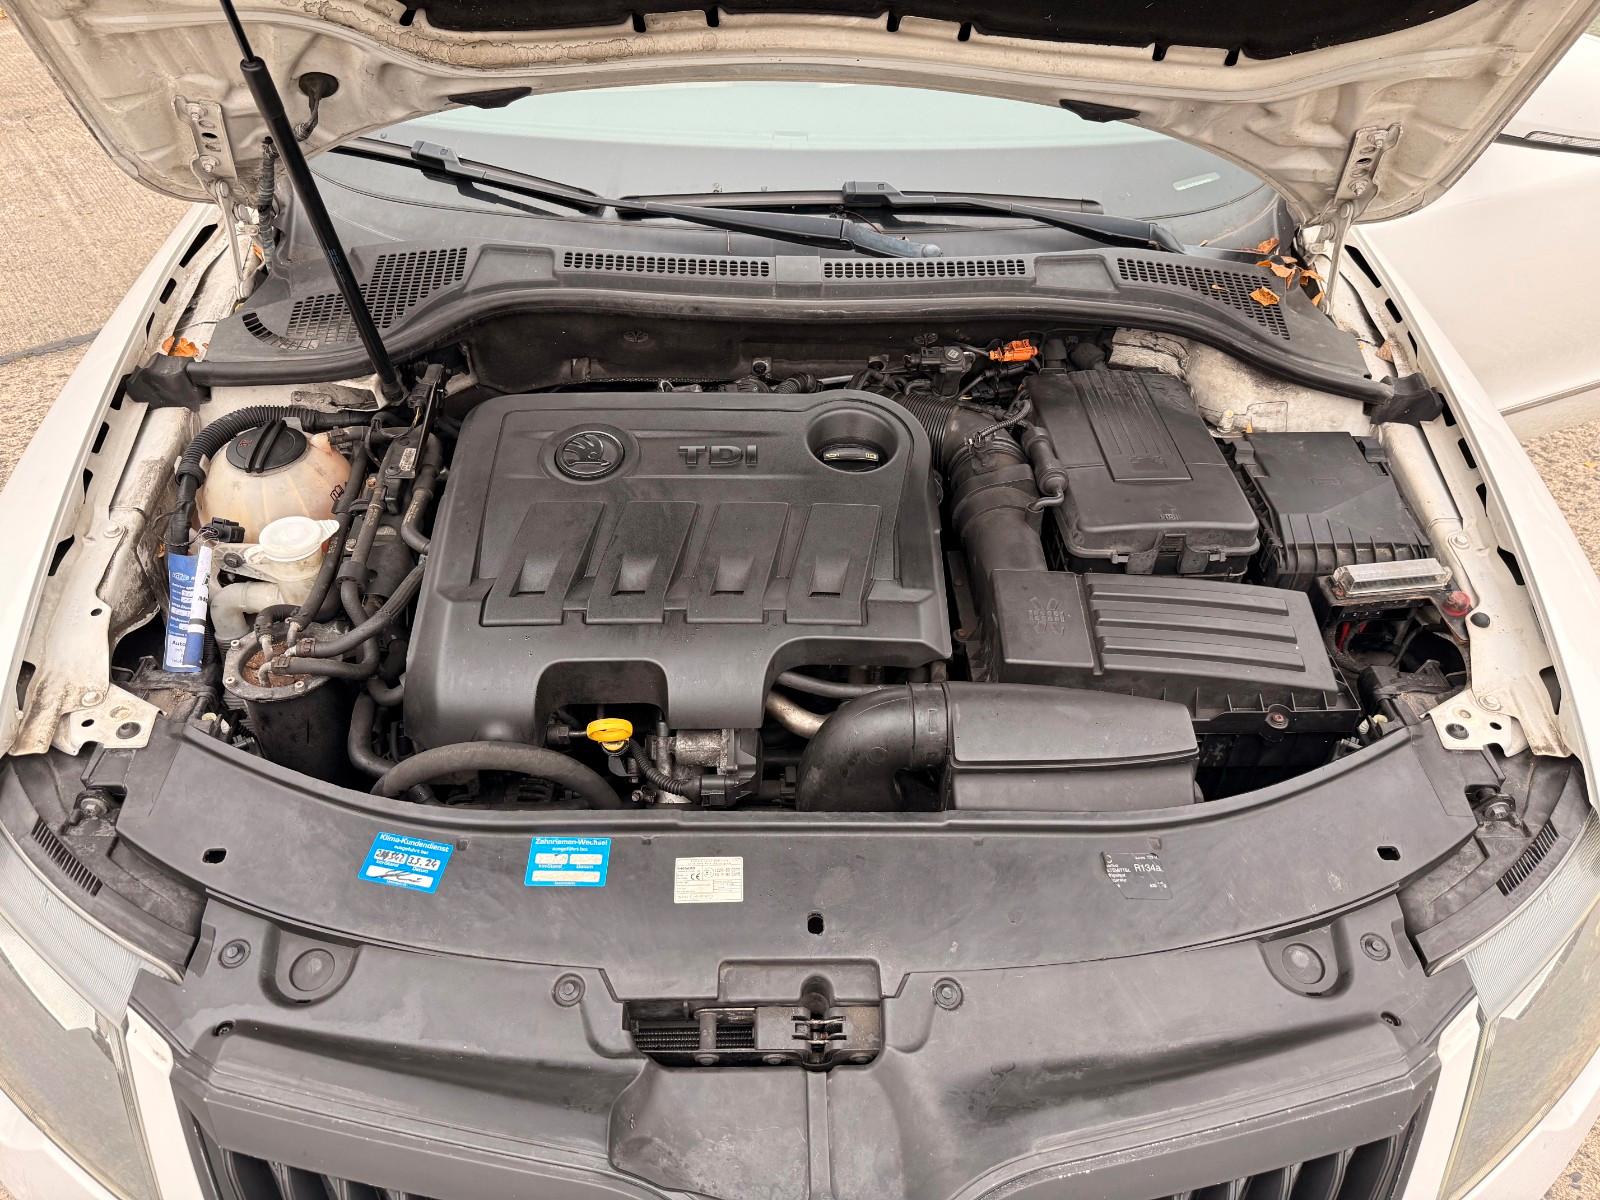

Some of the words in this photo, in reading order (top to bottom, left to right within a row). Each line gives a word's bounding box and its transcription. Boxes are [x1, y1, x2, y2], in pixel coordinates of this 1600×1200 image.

[678, 444, 758, 467] TDI
[379, 834, 450, 852] Klima-Kundendienst
[535, 838, 608, 846] Zahnriemen-Wechsel
[1133, 863, 1163, 872] R134a
